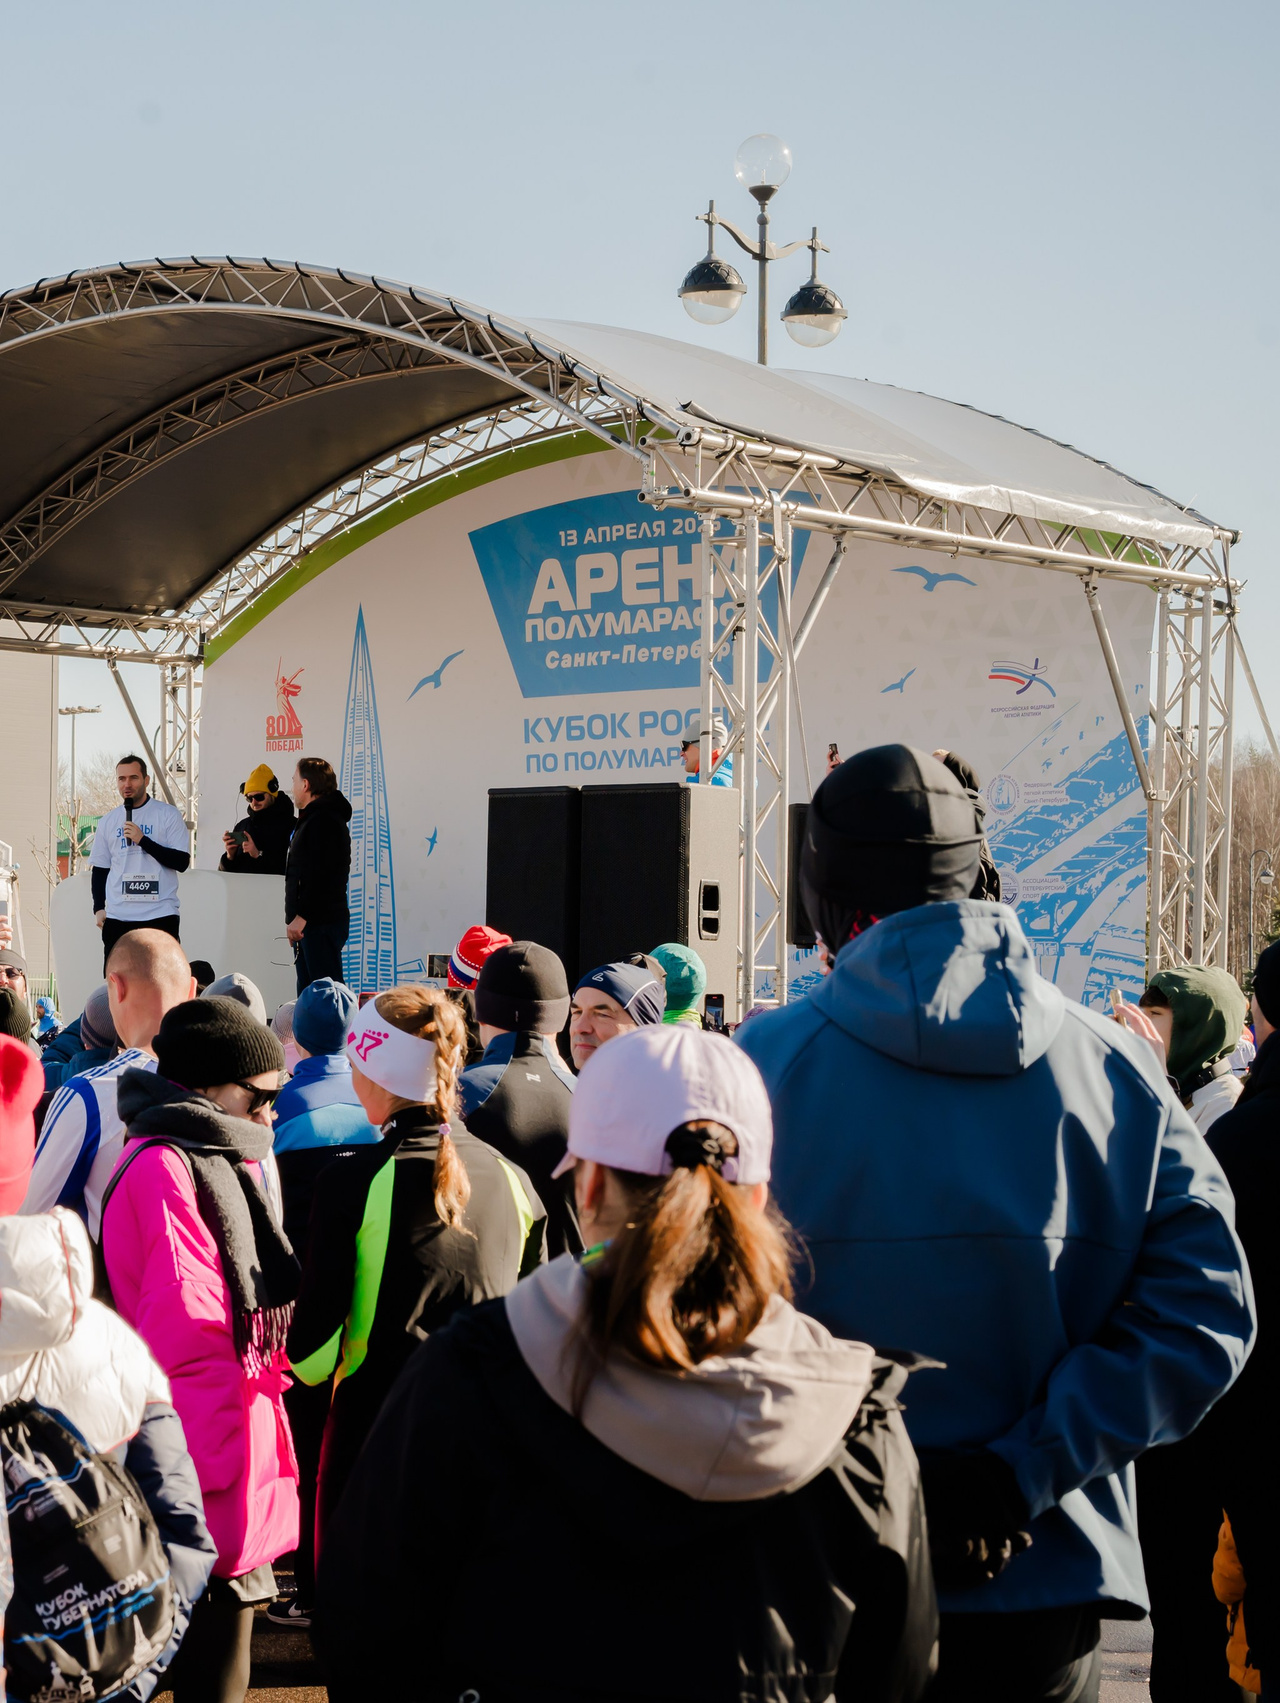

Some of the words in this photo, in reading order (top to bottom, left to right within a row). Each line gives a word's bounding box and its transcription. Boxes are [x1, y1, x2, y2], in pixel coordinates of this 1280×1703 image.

[559, 530, 578, 546] 13
[583, 520, 665, 544] АПРЕЛЯ
[265, 715, 287, 736] 80
[523, 711, 631, 744] КУБОК
[265, 740, 304, 752] ПОБЕДА!
[526, 753, 559, 773] ПО
[128, 882, 151, 891] 4469
[35, 1582, 89, 1617] КУБОК
[42, 1569, 149, 1631] ГУБЕРНАТОРА
